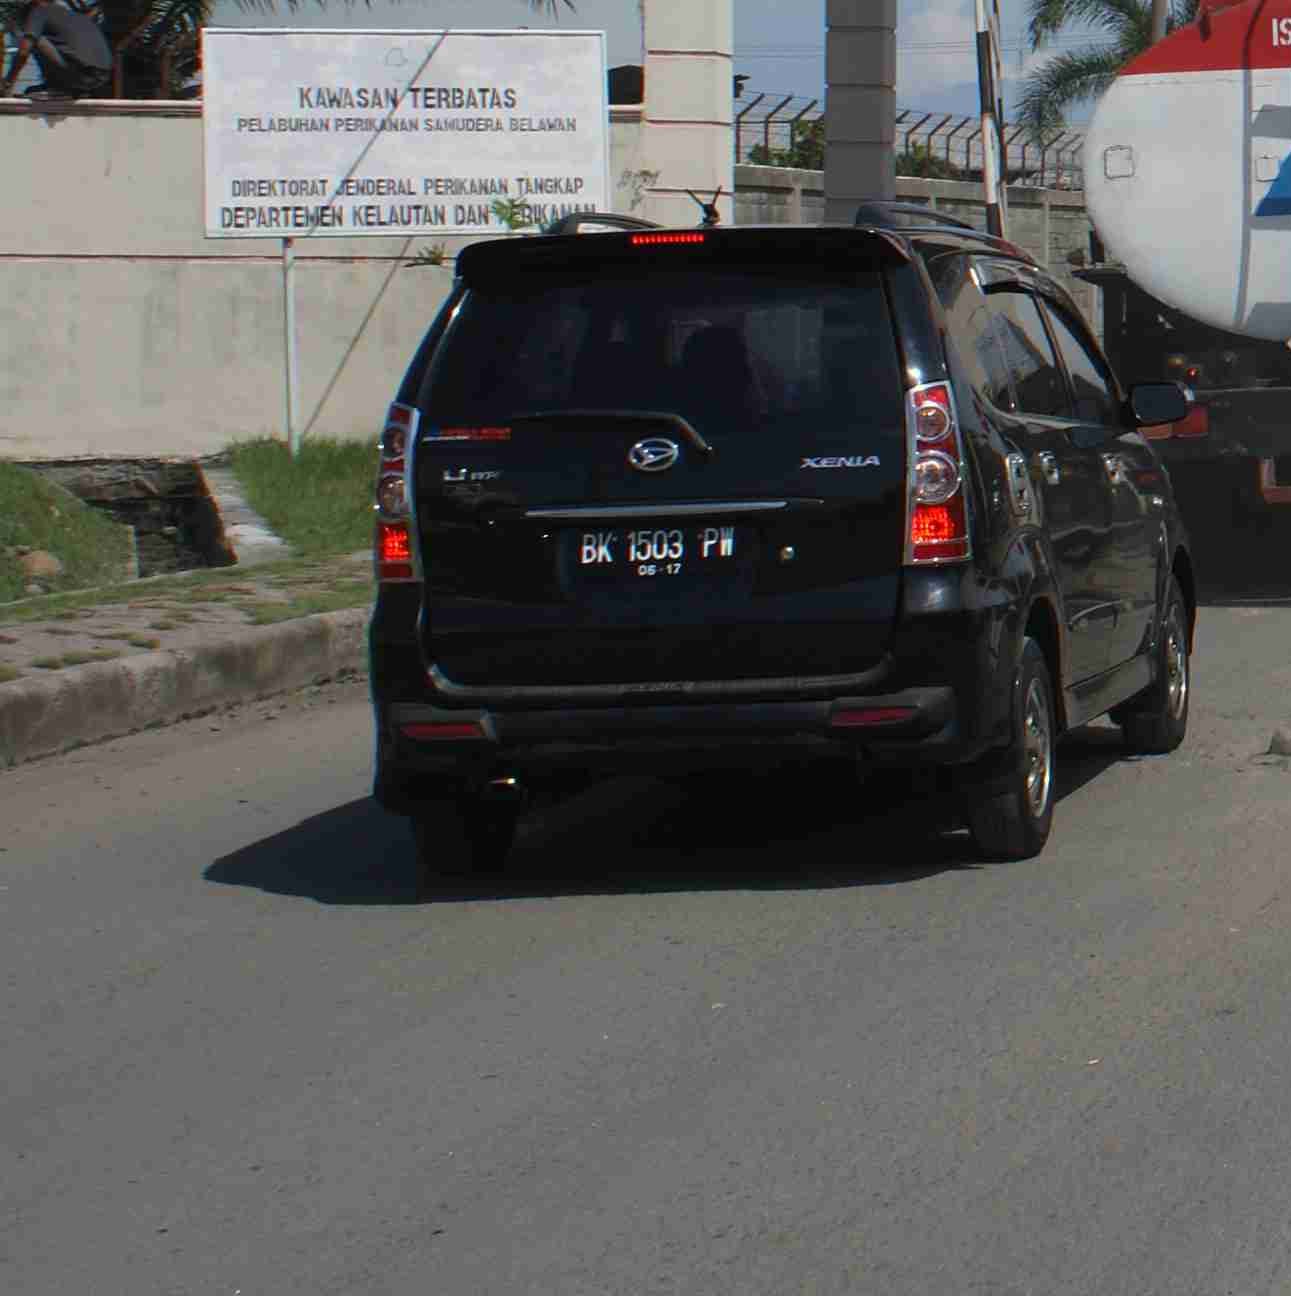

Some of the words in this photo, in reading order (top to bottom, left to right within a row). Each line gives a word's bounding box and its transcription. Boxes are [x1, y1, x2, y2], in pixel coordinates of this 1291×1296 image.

[299, 86, 398, 109] KAWASAN
[408, 87, 517, 109] TERBATAS
[237, 117, 330, 133] PELABUHAN
[335, 117, 419, 132] PERIKANAN
[424, 117, 504, 132] SAMUDERA
[509, 117, 577, 132] BELAWAN
[231, 179, 328, 197] DIREKTORAT
[335, 178, 416, 196] JENDERAL
[424, 177, 509, 195] PERIKANAN
[516, 177, 584, 195] TANGKAP
[221, 205, 343, 228] DEPARTEMEN
[352, 204, 446, 227] KELAUTAN
[454, 203, 489, 226] DAN
[800, 455, 880, 469] XENIA
[581, 533, 613, 564] BK
[627, 529, 684, 562] 1503
[703, 526, 735, 558] PW
